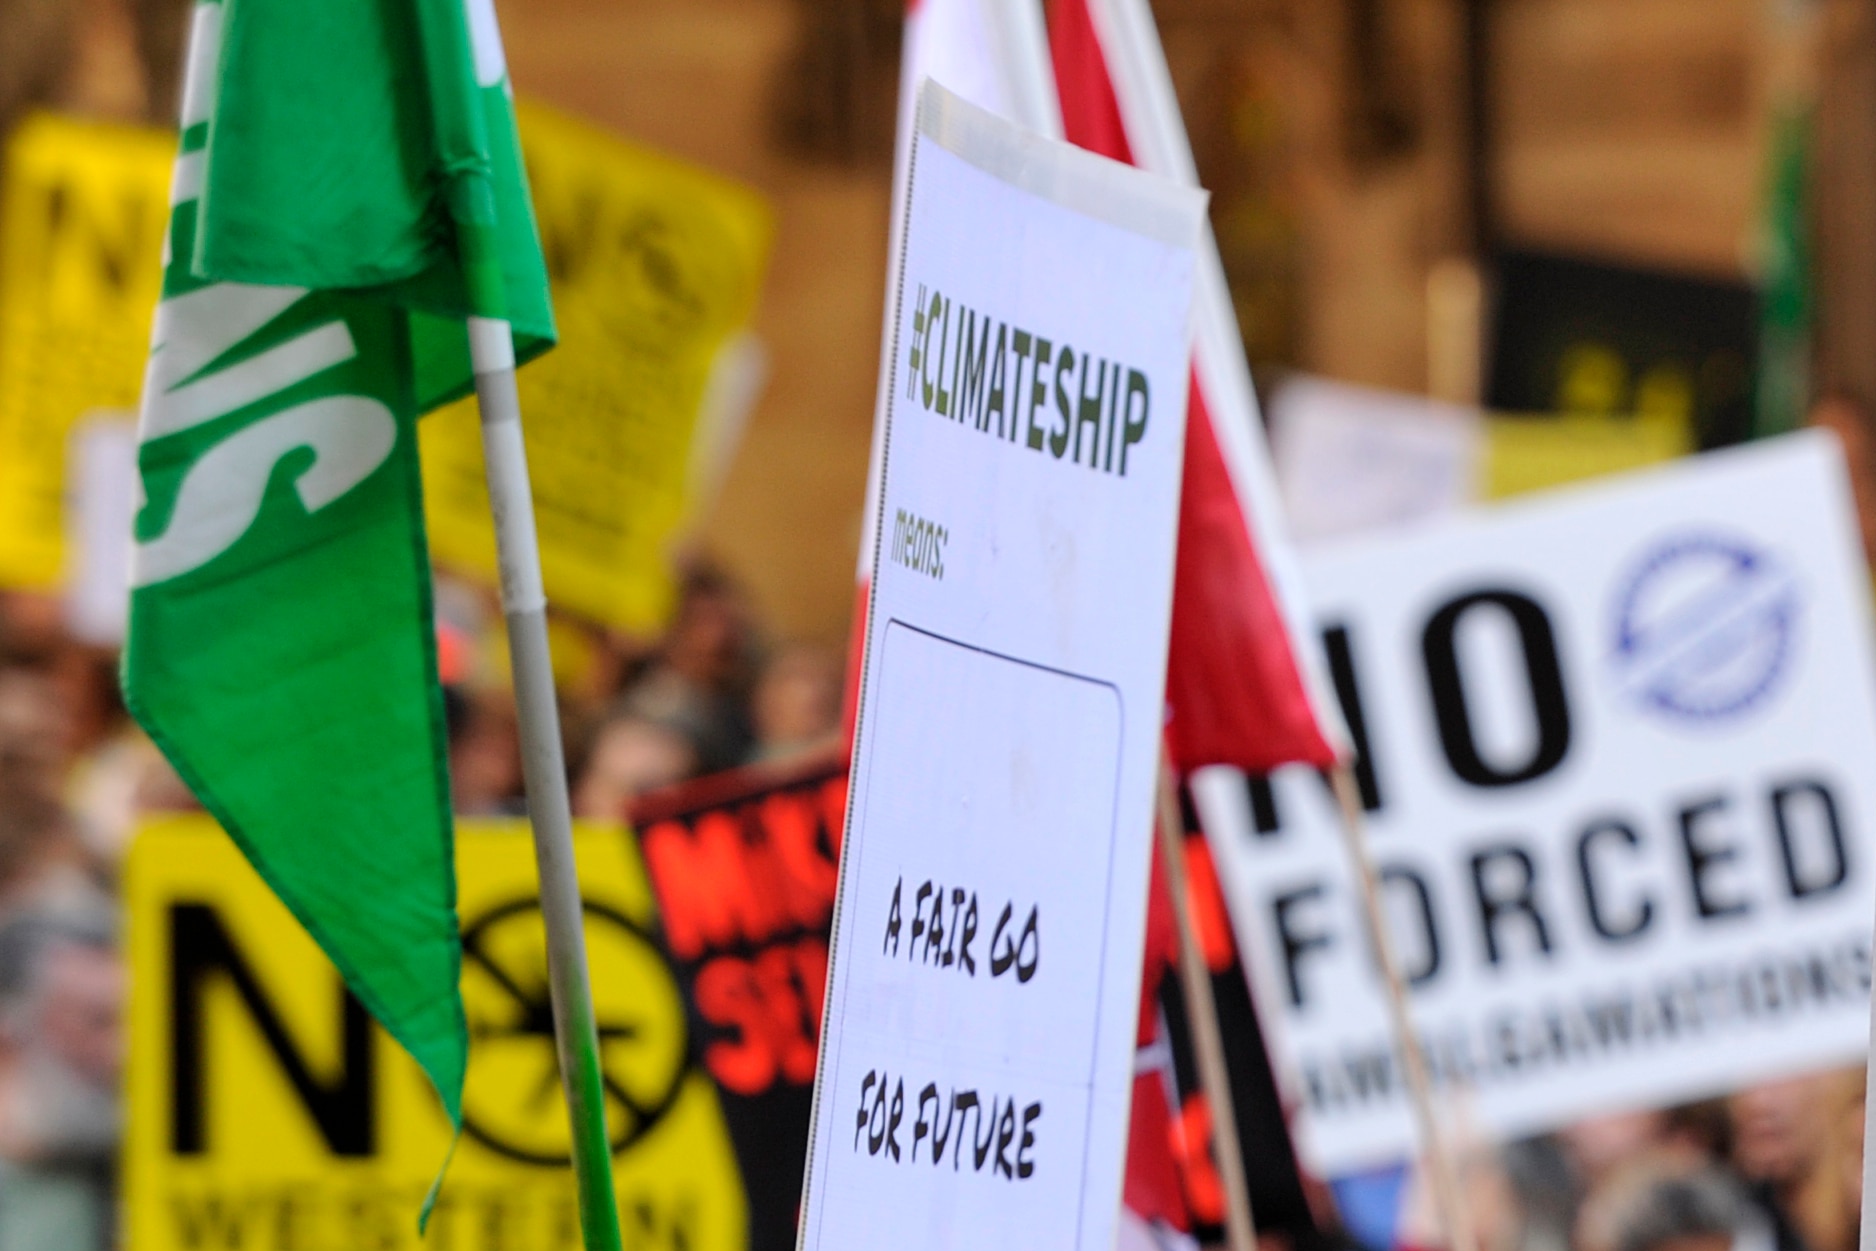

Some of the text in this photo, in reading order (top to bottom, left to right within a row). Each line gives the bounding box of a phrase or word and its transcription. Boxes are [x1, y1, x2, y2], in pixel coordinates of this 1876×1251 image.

[906, 282, 1150, 478] #CLIMATESHIP
[892, 508, 949, 580] means:
[884, 875, 1041, 984] A FAIR GO
[1270, 776, 1850, 1008] FORCED
[854, 1069, 1043, 1182] FOR FUTURE
